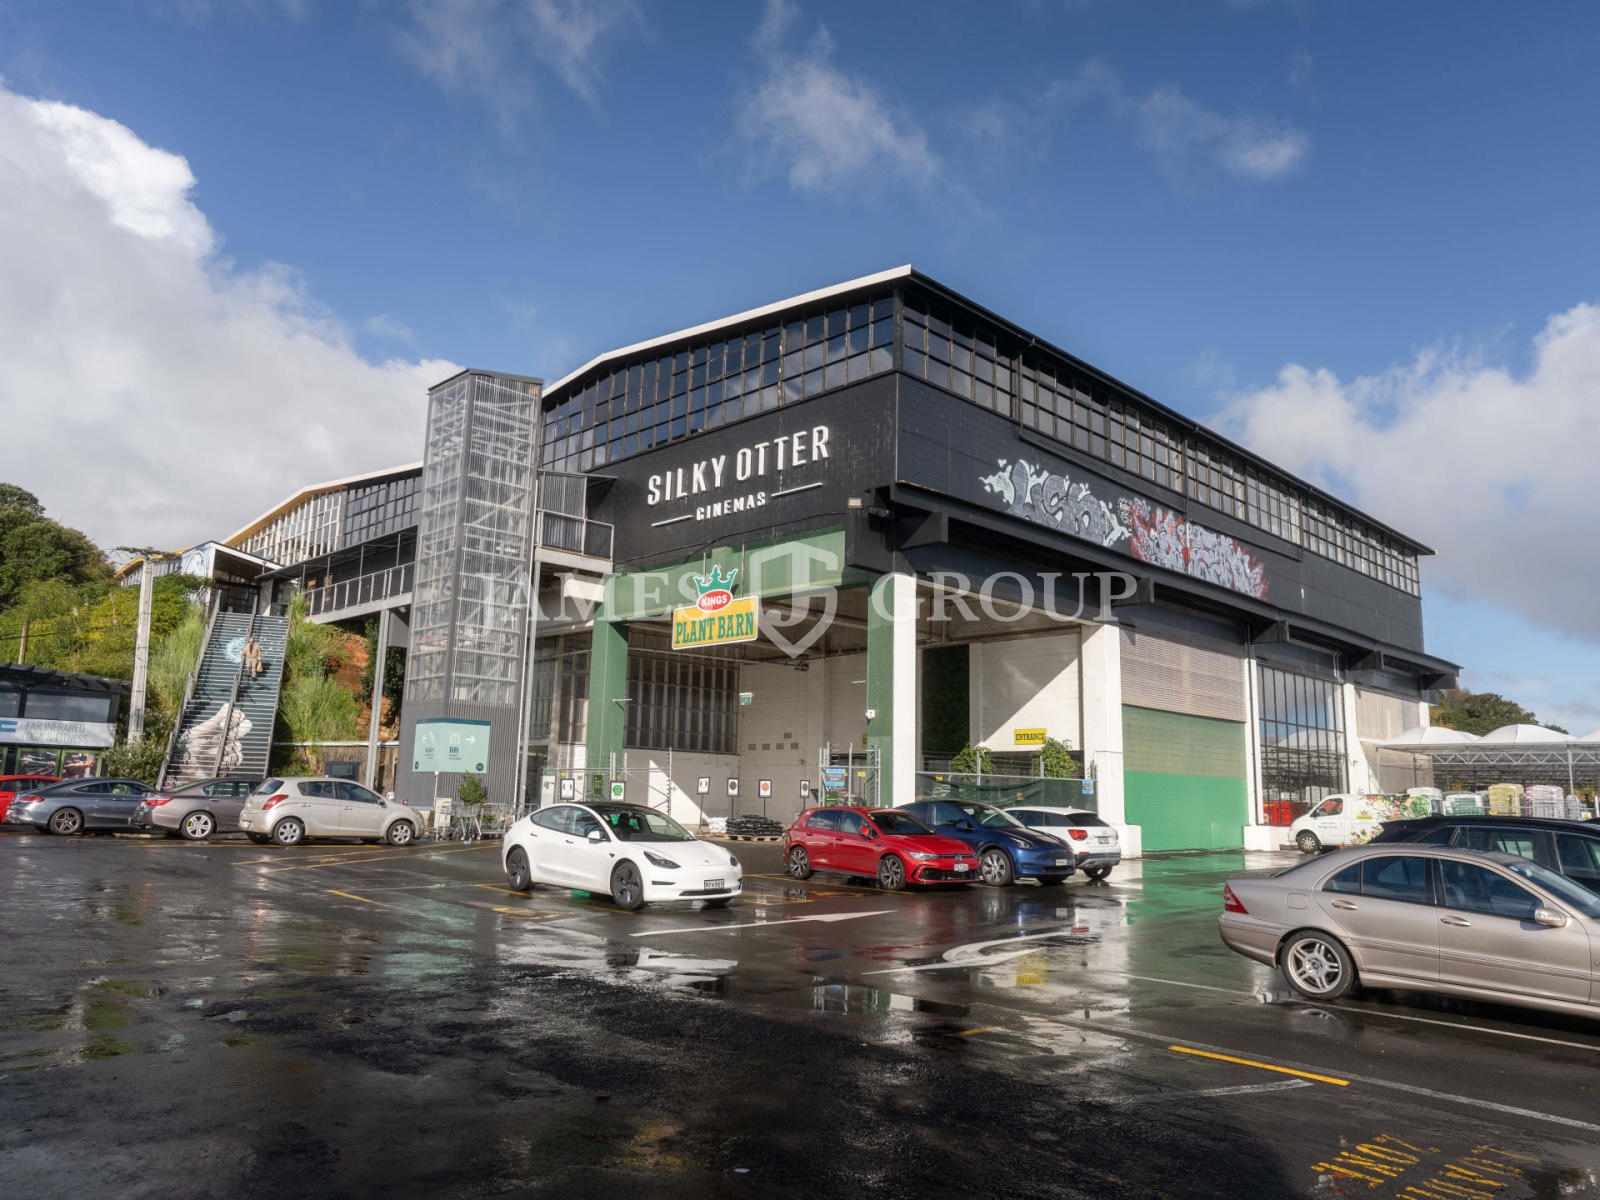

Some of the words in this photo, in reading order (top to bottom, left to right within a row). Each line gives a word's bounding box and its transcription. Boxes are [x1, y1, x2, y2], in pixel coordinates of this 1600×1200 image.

[647, 454, 727, 506] SILKY
[735, 425, 829, 482] OTTER
[695, 491, 767, 521] CINEMAS
[700, 594, 728, 607] KINGS
[675, 616, 715, 644] PLANT
[717, 611, 754, 640] BARN
[1015, 732, 1046, 741] ENTRANCE
